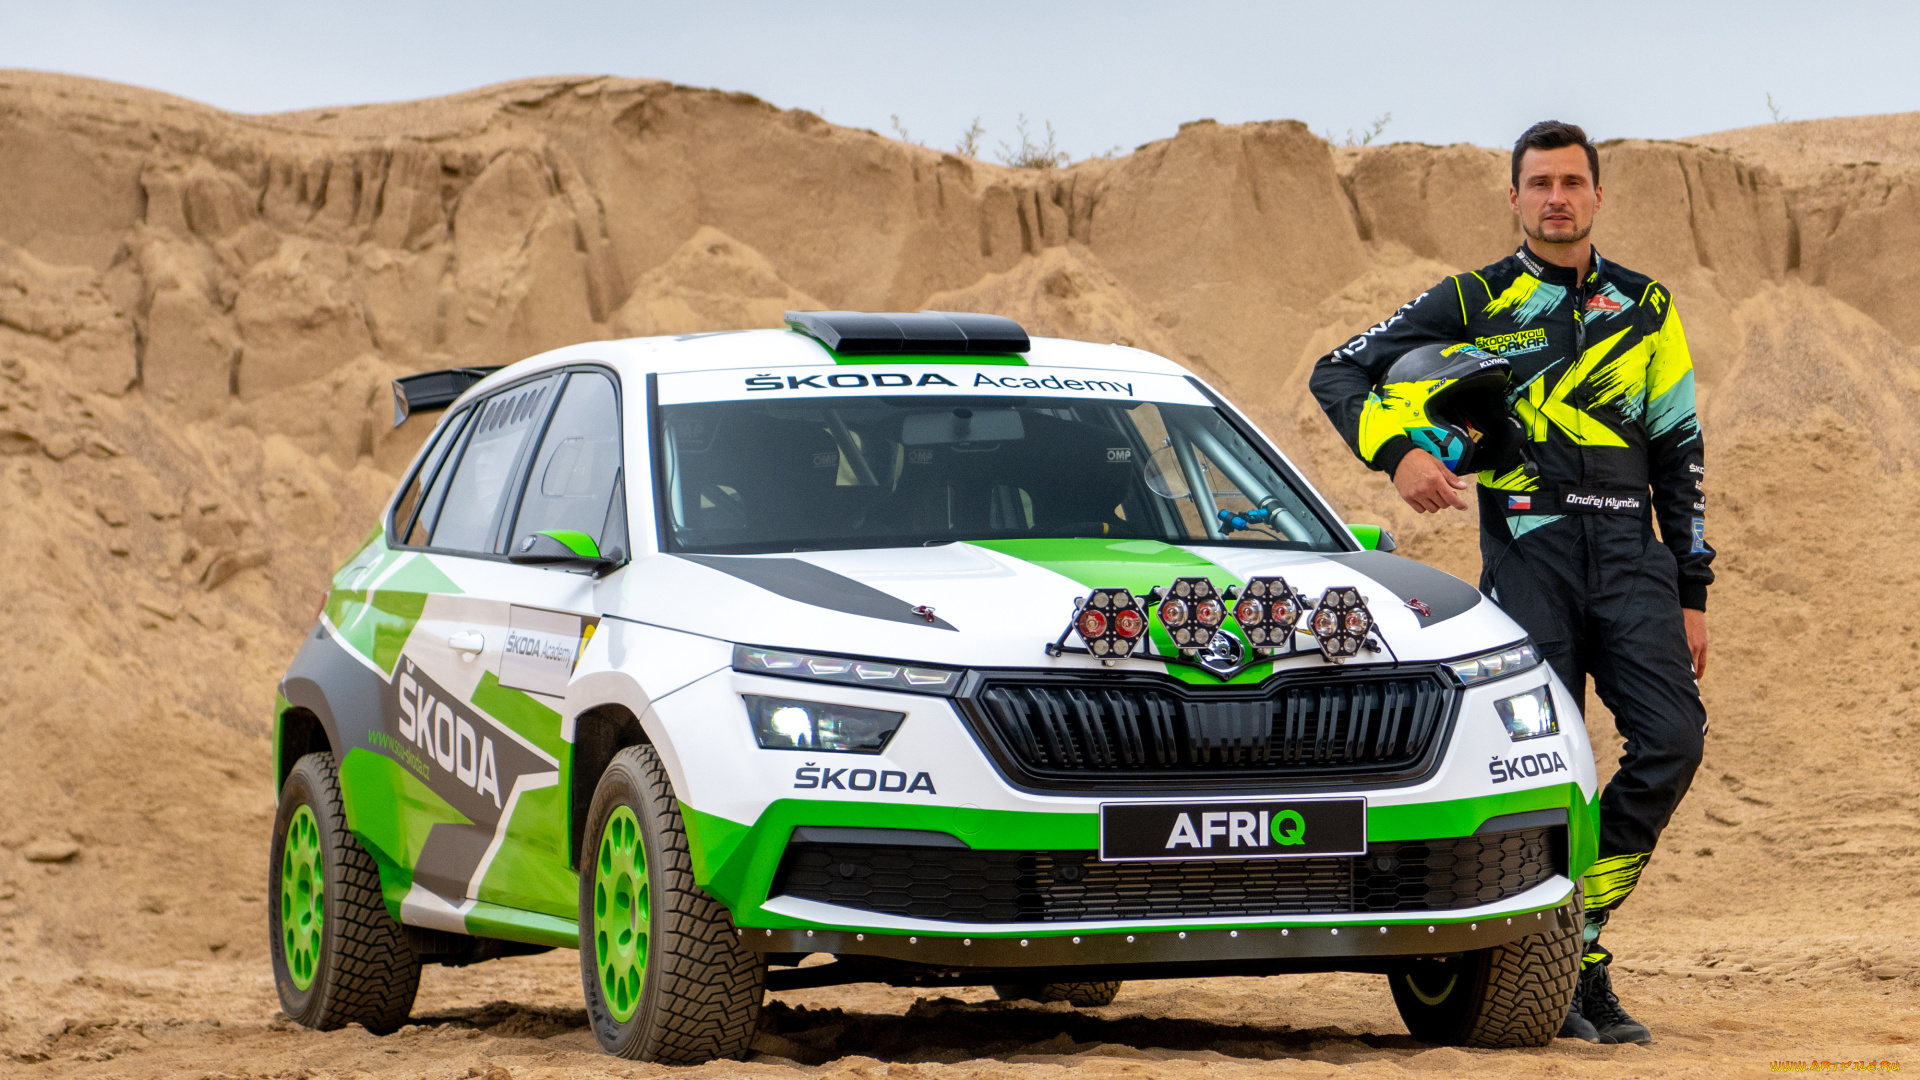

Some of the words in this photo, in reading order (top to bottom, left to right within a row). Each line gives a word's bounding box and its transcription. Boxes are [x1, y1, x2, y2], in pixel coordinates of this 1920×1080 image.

[1498, 336, 1547, 354] DAKAR
[745, 373, 958, 391] ŠKODA
[973, 372, 1134, 397] Academy
[1106, 450, 1132, 461] OMP
[1566, 493, 1604, 508] Ondřej
[505, 630, 540, 658] ŠKODA
[541, 639, 575, 669] Academy
[398, 658, 502, 810] ŠKODA
[793, 762, 938, 795] ŠKODA
[1488, 751, 1568, 784] ŠKODA
[1165, 809, 1306, 849] AFRIQ
